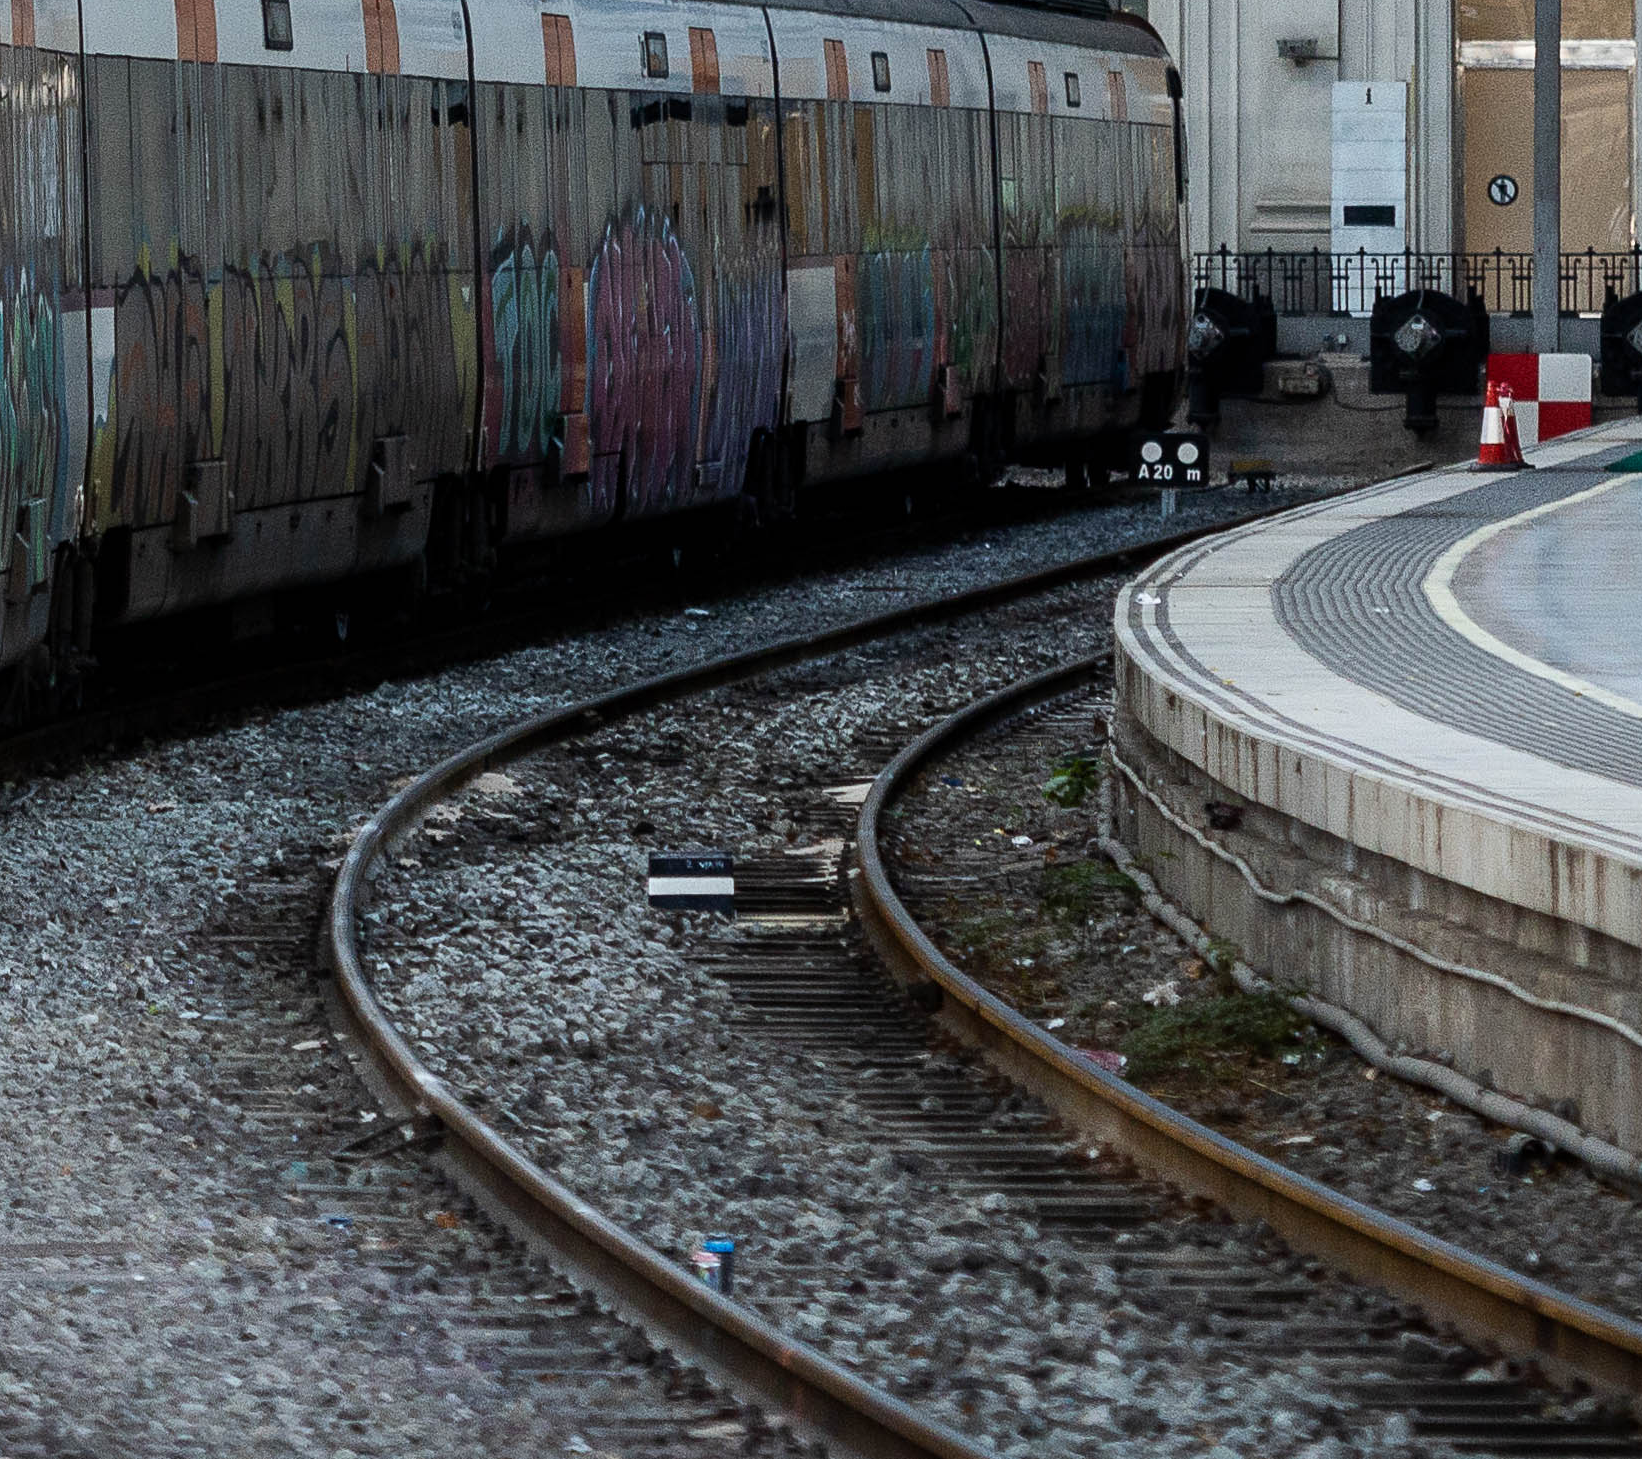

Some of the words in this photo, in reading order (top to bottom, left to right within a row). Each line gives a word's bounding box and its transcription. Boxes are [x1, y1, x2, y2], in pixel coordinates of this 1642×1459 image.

[1138, 463, 1150, 479] A
[1153, 464, 1173, 480] 20
[1186, 468, 1201, 481] m
